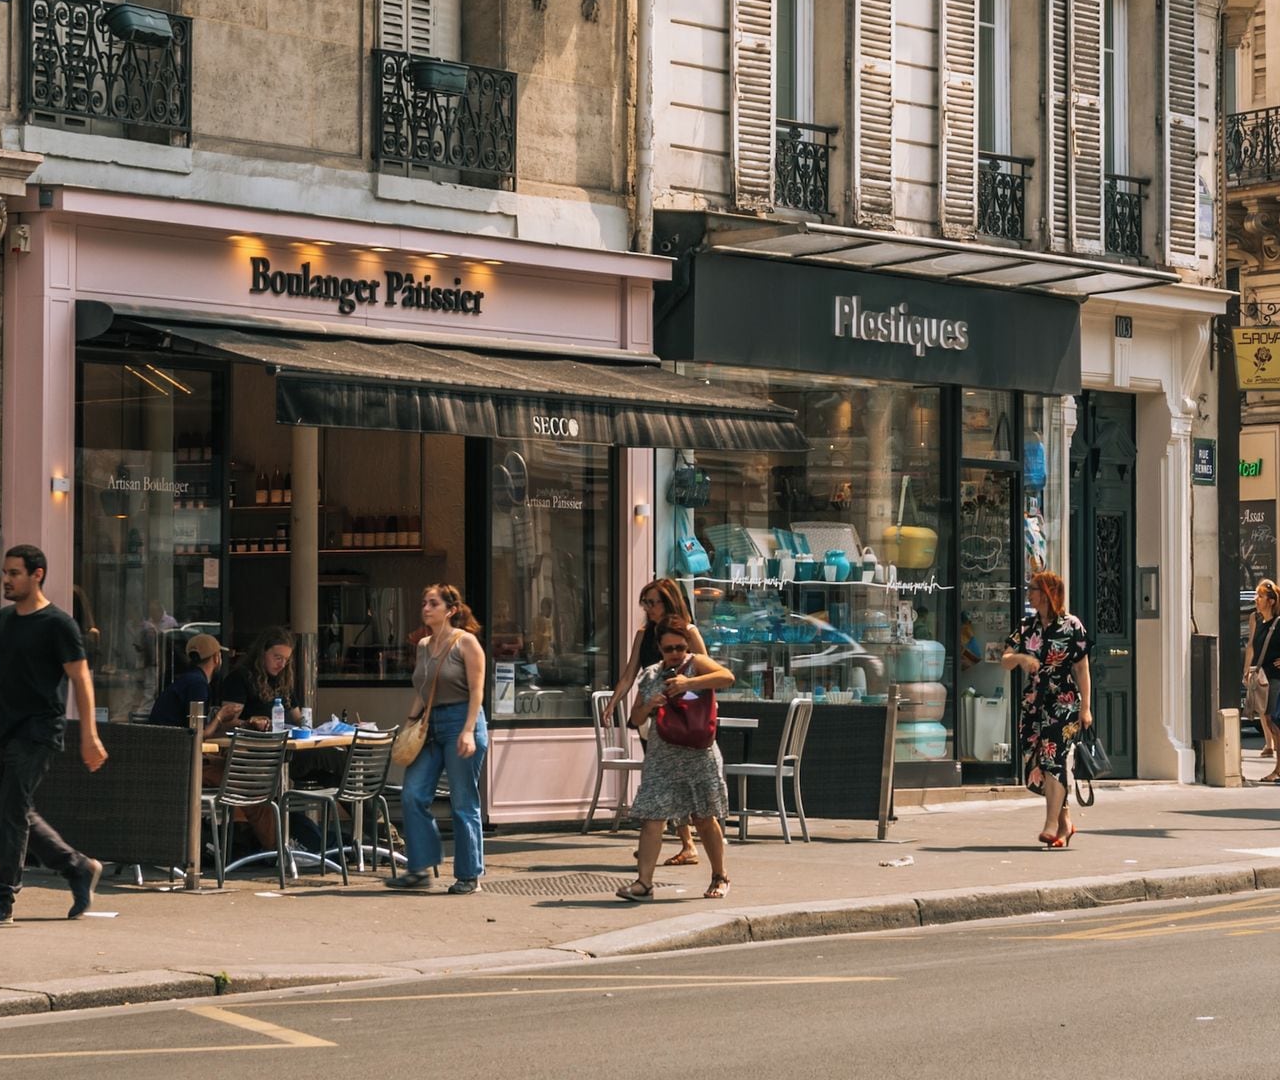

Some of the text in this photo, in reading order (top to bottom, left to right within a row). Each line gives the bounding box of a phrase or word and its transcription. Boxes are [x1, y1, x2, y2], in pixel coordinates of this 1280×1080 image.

[249, 256, 484, 315] Boulanger Pâtissier
[834, 295, 969, 357] Plastiques
[1117, 317, 1131, 338] 103
[532, 416, 579, 437] SECCO
[1198, 449, 1209, 460] RUE
[1194, 463, 1213, 474] RENNES
[107, 475, 189, 497] Artisan Boulanger
